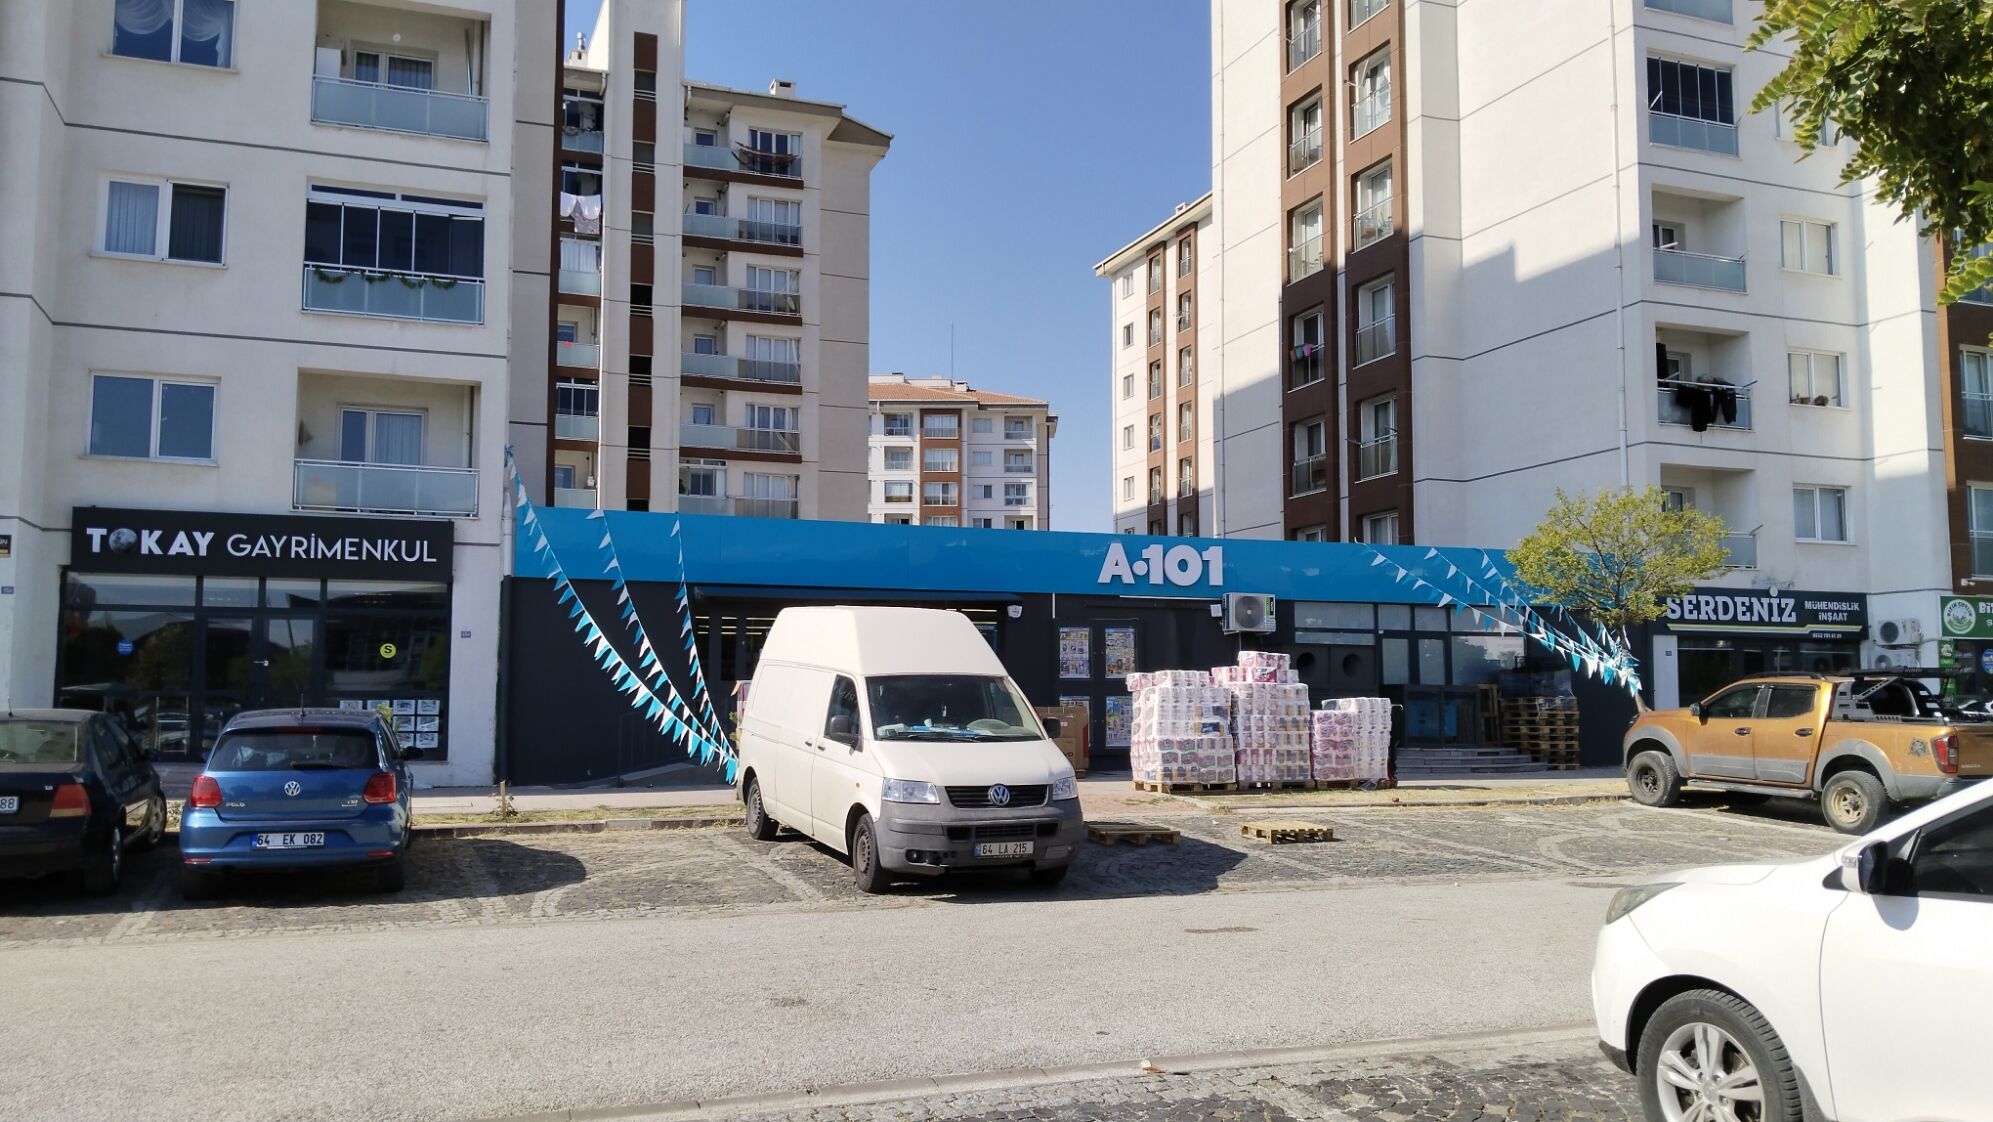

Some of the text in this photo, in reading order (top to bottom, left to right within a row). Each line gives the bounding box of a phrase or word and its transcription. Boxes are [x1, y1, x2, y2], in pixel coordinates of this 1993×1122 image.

[86, 528, 437, 562] TOKAY GAYRİMENKUL
[1666, 587, 1797, 622] SERDENİZ
[1818, 612, 1848, 622] İNŞAAT
[257, 833, 323, 846] 64 EK 082
[982, 844, 992, 855] 64
[998, 844, 1008, 854] LA
[1013, 843, 1027, 853] 215
